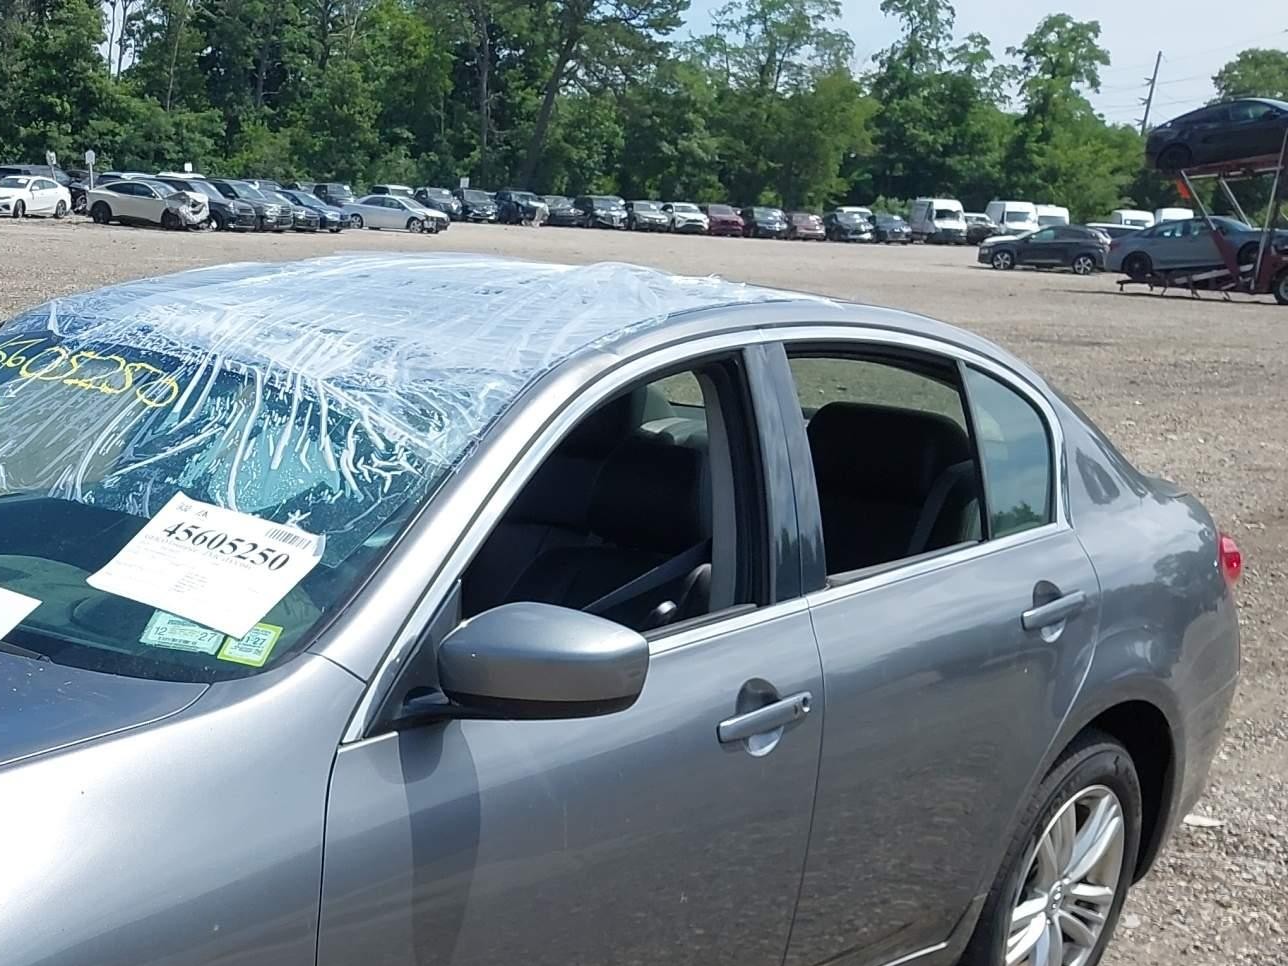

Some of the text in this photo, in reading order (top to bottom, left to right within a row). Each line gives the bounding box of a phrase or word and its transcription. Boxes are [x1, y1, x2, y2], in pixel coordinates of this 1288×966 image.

[163, 522, 290, 571] 45605250
[154, 626, 168, 636] 12
[198, 631, 216, 642] 27
